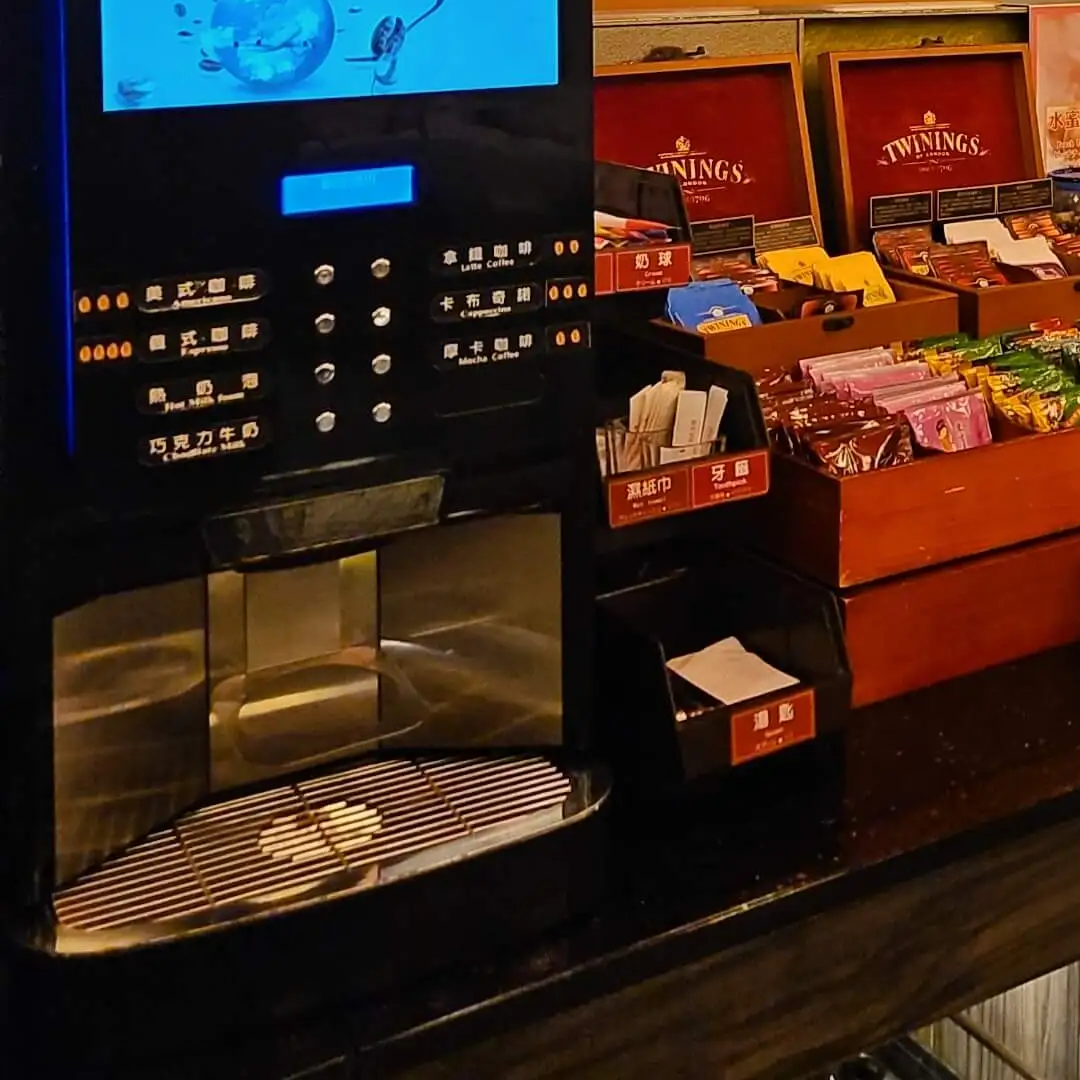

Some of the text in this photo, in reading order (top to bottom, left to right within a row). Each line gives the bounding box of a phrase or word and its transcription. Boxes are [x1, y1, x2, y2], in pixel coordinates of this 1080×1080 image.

[882, 130, 980, 163] TWININGS
[635, 251, 673, 269] 奶球
[149, 422, 260, 455] 巧克力牛奶
[627, 476, 672, 501] 濕紙巾
